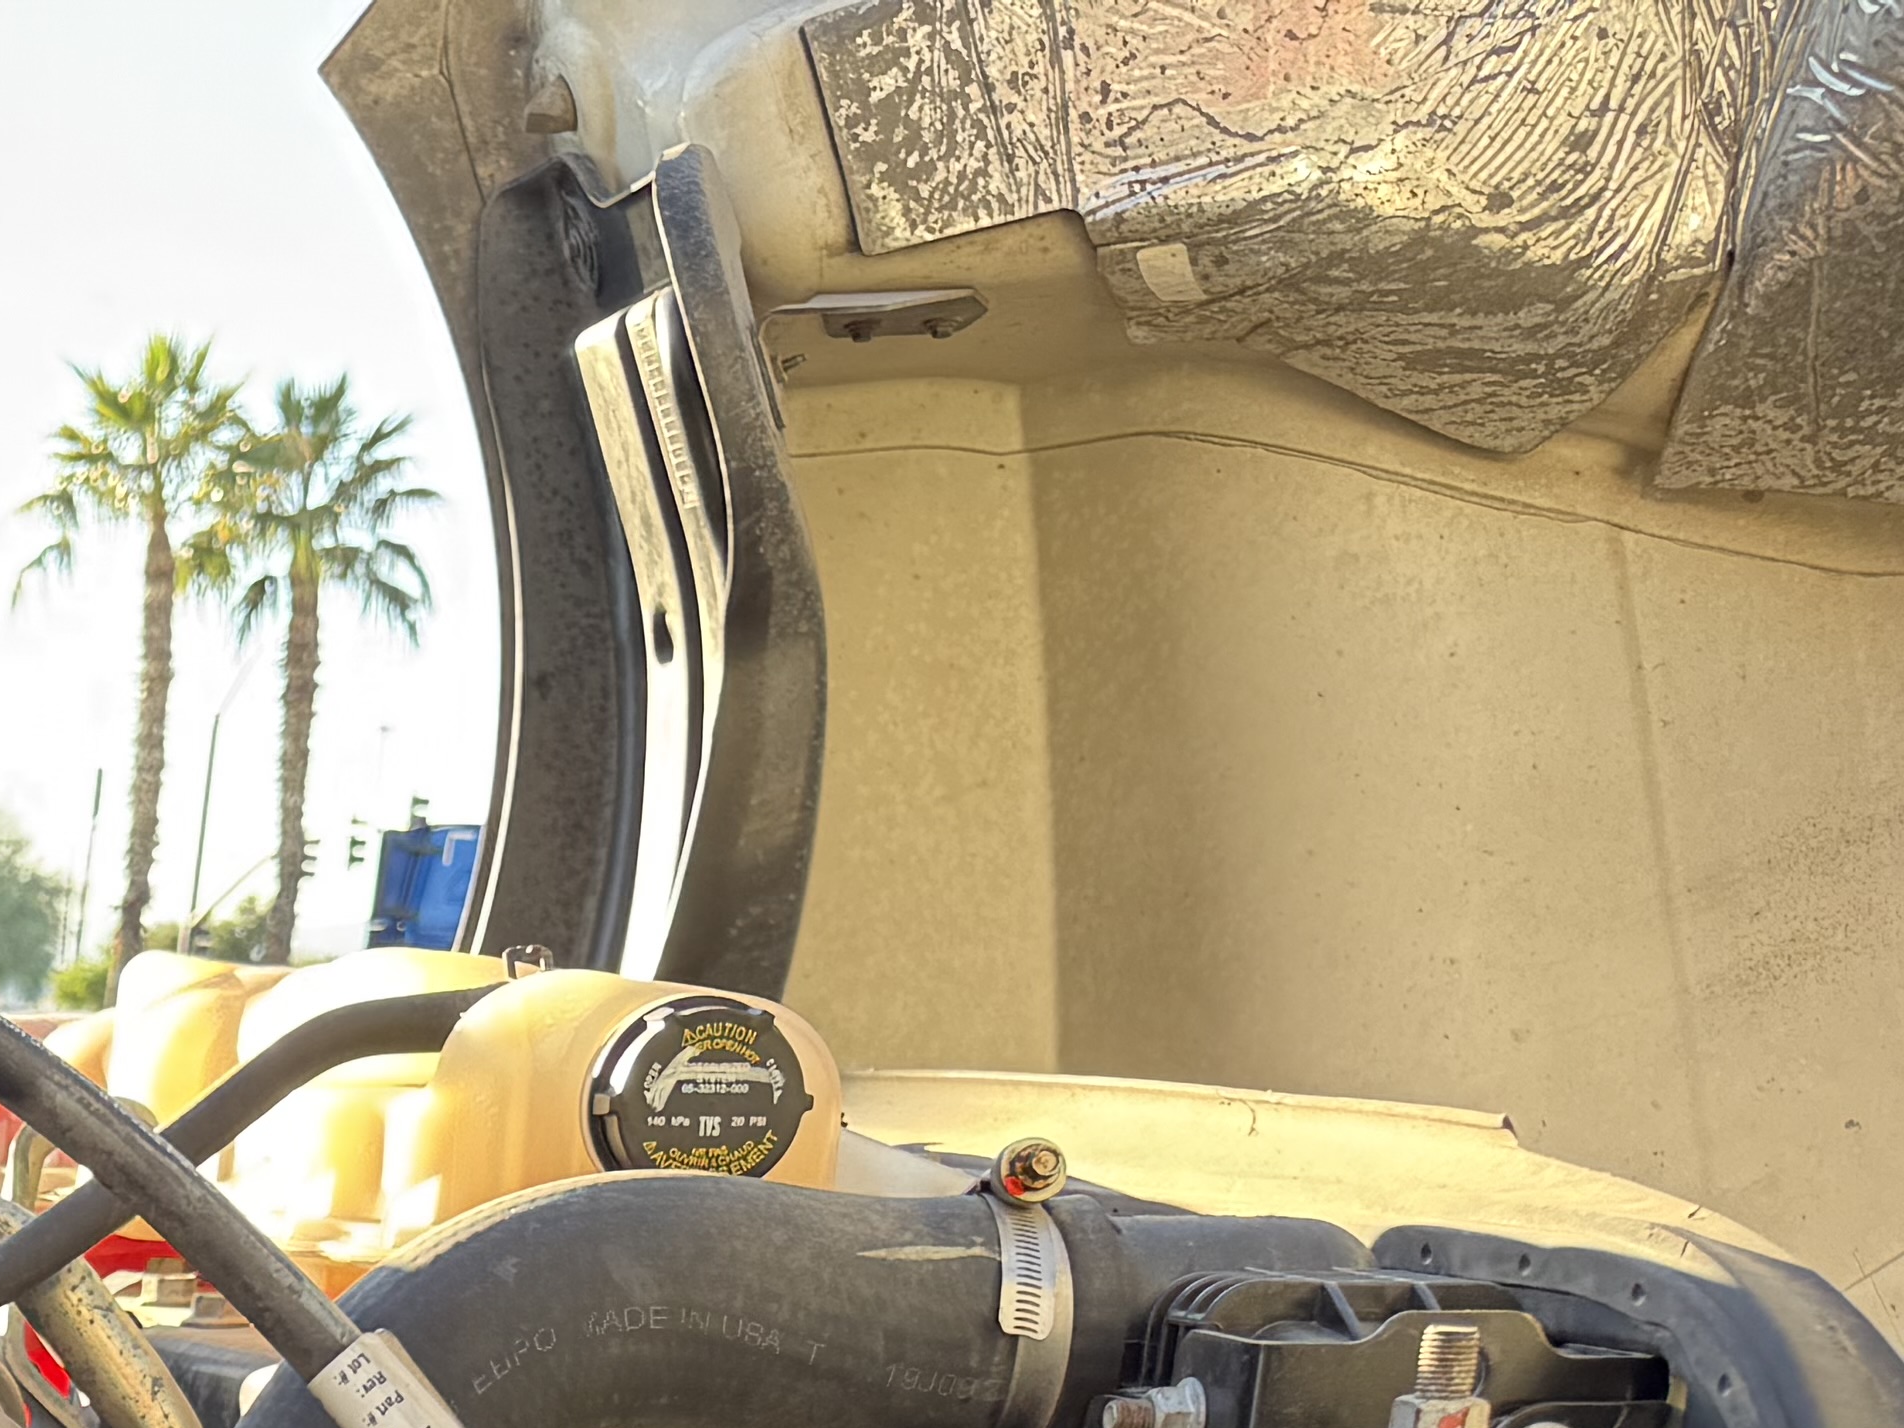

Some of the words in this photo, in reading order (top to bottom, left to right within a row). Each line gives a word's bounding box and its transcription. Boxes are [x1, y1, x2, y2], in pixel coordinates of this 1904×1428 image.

[695, 1022, 758, 1045] CAUTION
[699, 1116, 722, 1137] TVS
[347, 1352, 371, 1374] Lot
[355, 1370, 387, 1399] Rev:
[376, 1389, 405, 1416] Part
